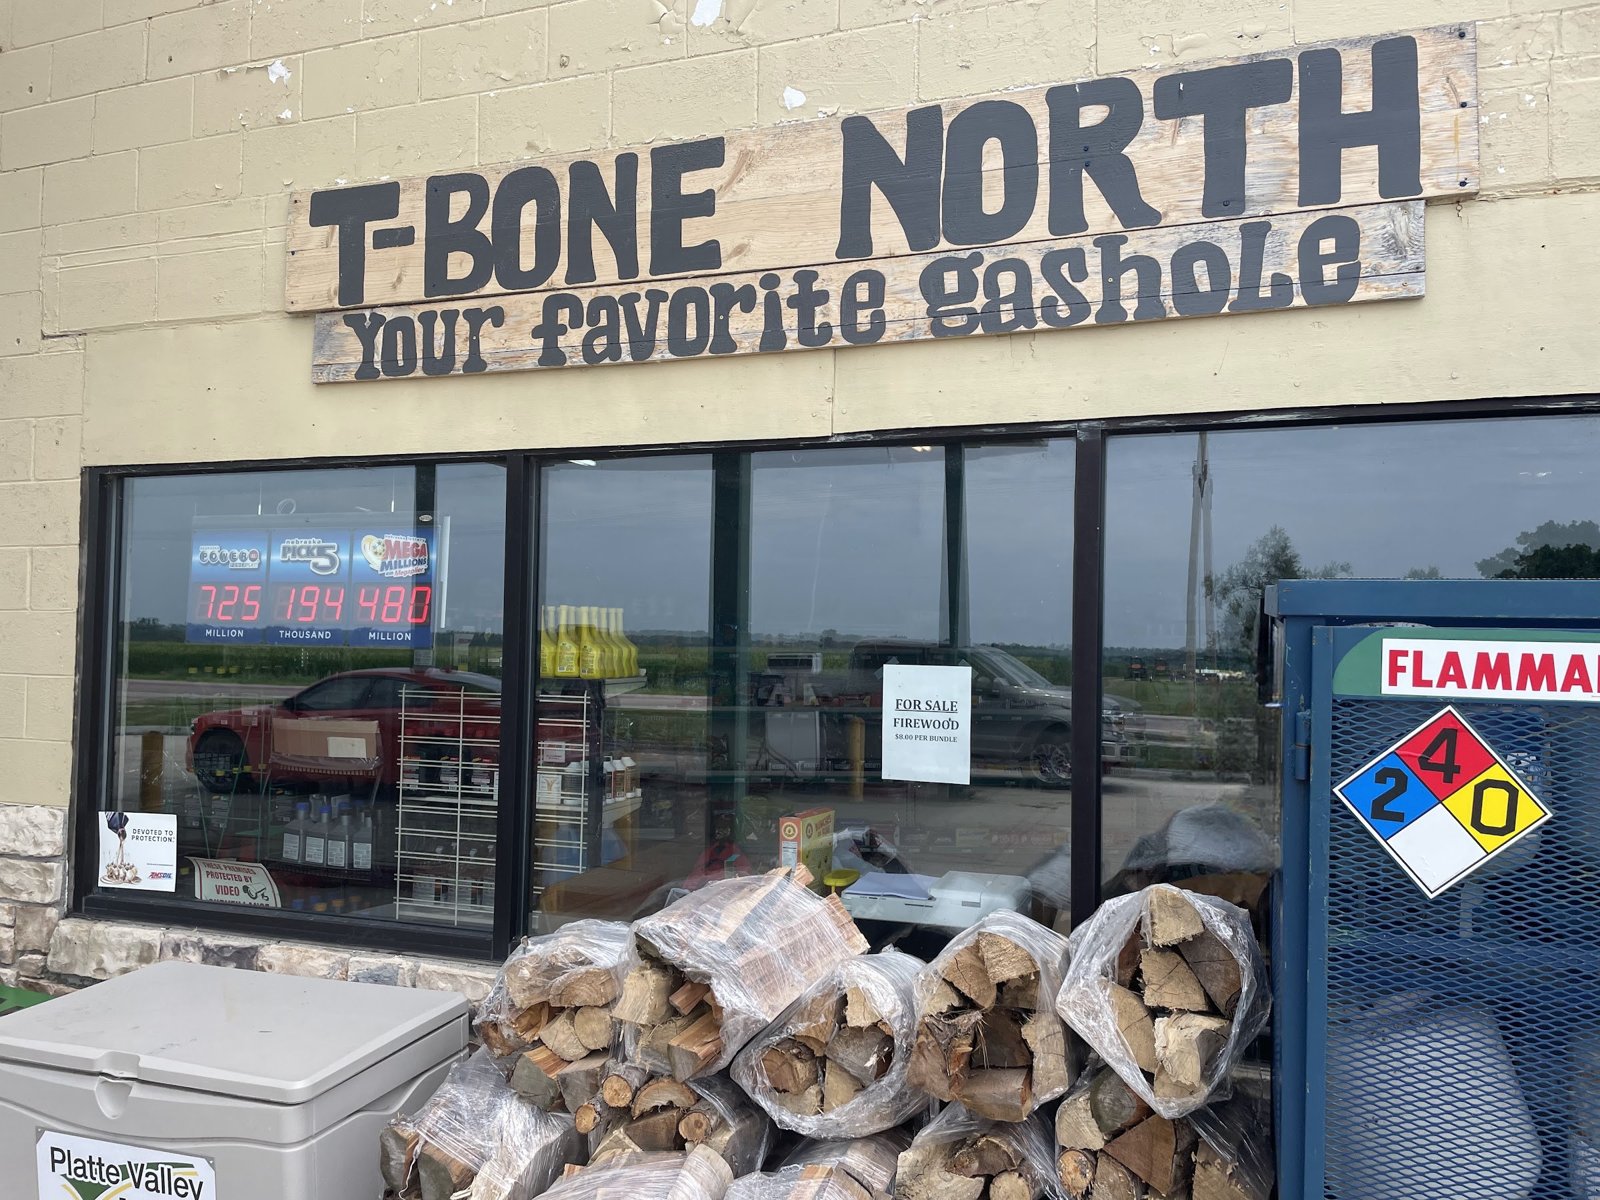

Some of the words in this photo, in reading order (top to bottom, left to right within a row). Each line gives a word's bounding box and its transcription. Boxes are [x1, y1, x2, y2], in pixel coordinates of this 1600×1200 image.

[309, 136, 726, 306] T-BONE
[836, 35, 1423, 260] NORTH
[531, 269, 887, 367] favorite
[281, 544, 318, 559] PICK
[310, 543, 339, 574] 5
[384, 538, 427, 560] MEGA
[380, 558, 427, 572] MILLIONS
[201, 585, 262, 622] 725
[285, 586, 345, 622] 194
[359, 586, 431, 623] 480
[205, 629, 245, 638] MILLION
[279, 630, 332, 640] THOUSAND
[368, 632, 412, 641] MILLION
[1388, 649, 1600, 694] FLAMMA
[895, 699, 921, 710] FOR
[925, 700, 958, 712] SALE
[893, 718, 960, 731] FIREWOOD
[929, 735, 958, 743] BUNDLE
[1417, 727, 1461, 784] 4
[1370, 767, 1408, 822] 2
[1470, 778, 1519, 837] 0
[132, 828, 163, 836] DEVOTED
[206, 870, 243, 882] PROTECTED
[243, 875, 253, 883] BY
[215, 884, 240, 897] VIDEO
[50, 1146, 121, 1185] Platte
[127, 1160, 204, 1200] Valley
